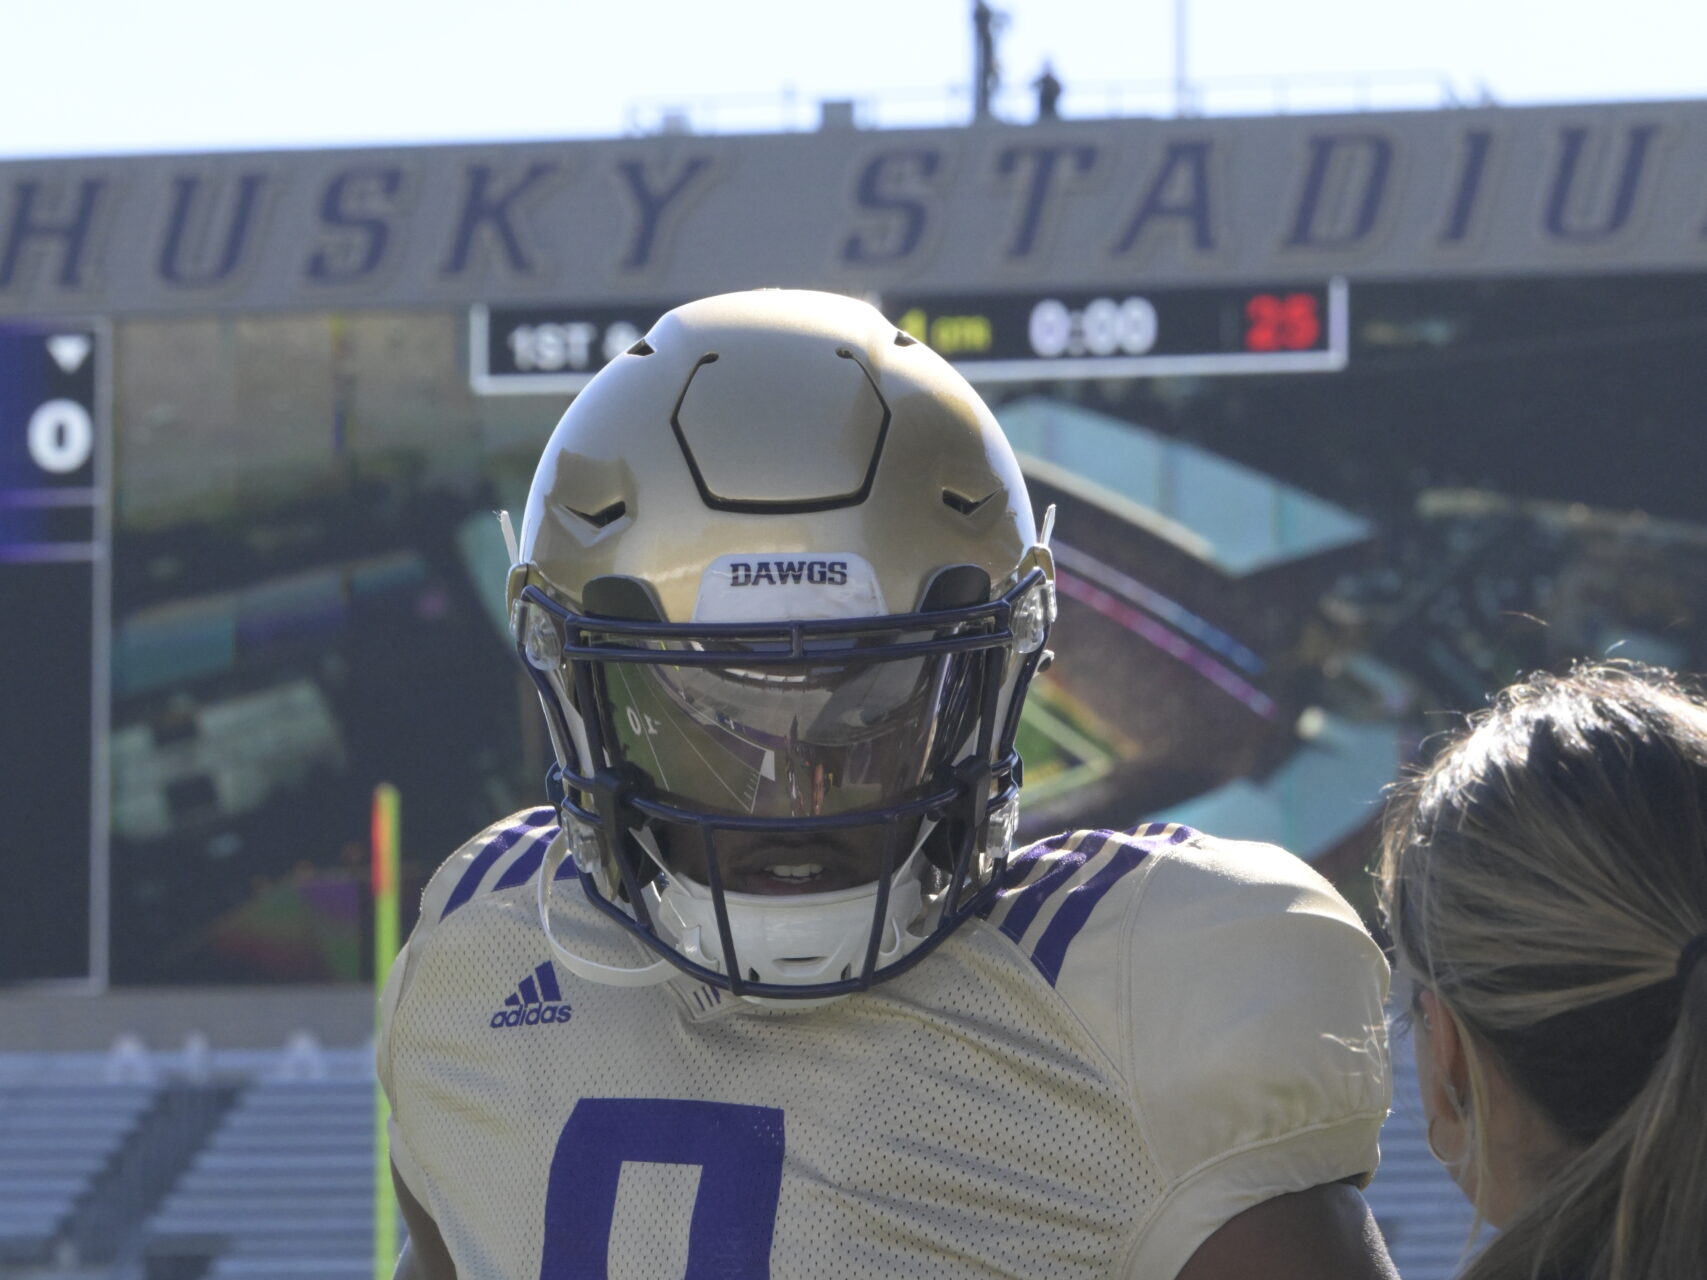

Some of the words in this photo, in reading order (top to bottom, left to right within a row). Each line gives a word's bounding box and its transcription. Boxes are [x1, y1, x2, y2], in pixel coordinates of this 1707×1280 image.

[0, 153, 714, 290] HUSKY
[841, 122, 1707, 266] STADIU
[1028, 297, 1158, 358] 0:00
[27, 398, 93, 474] 0
[729, 560, 848, 587] DAWGS
[489, 1001, 572, 1028] adidas
